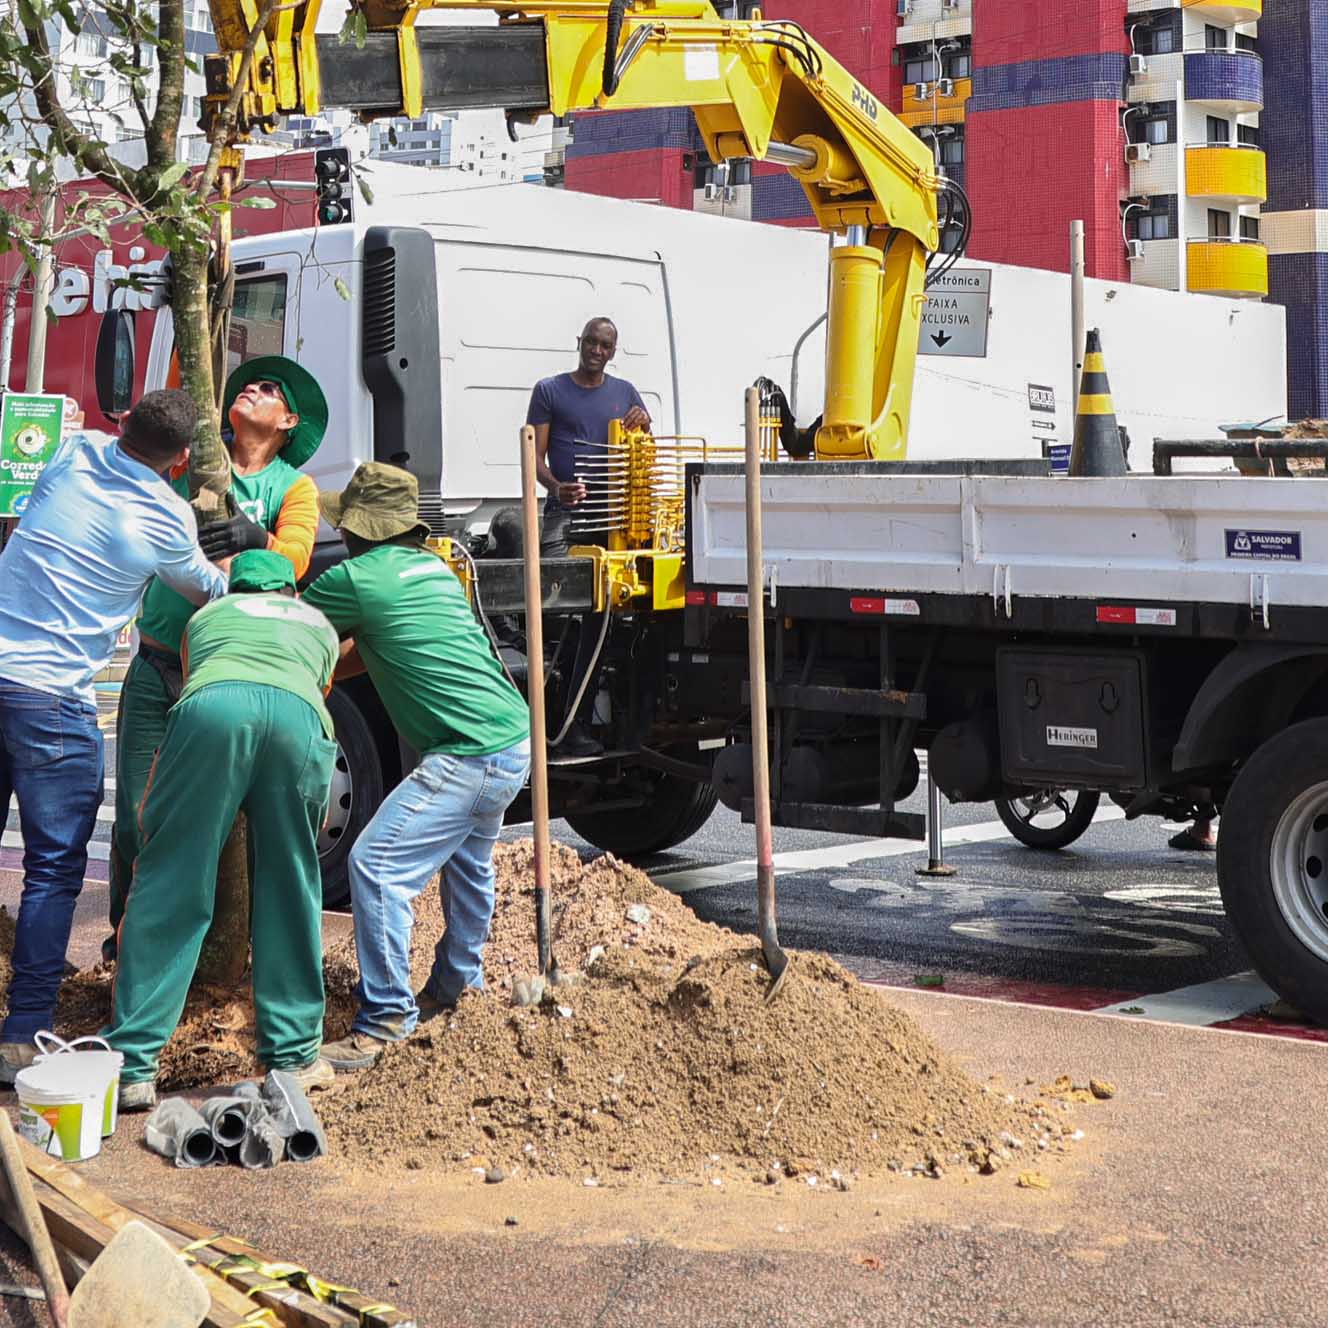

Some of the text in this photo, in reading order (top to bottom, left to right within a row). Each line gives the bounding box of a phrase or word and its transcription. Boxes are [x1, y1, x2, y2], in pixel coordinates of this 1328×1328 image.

[928, 298, 958, 309] FAIXA
[922, 313, 970, 325] XCLUSIVA
[12, 470, 41, 480] Verd
[1251, 535, 1293, 544] SALVADOR
